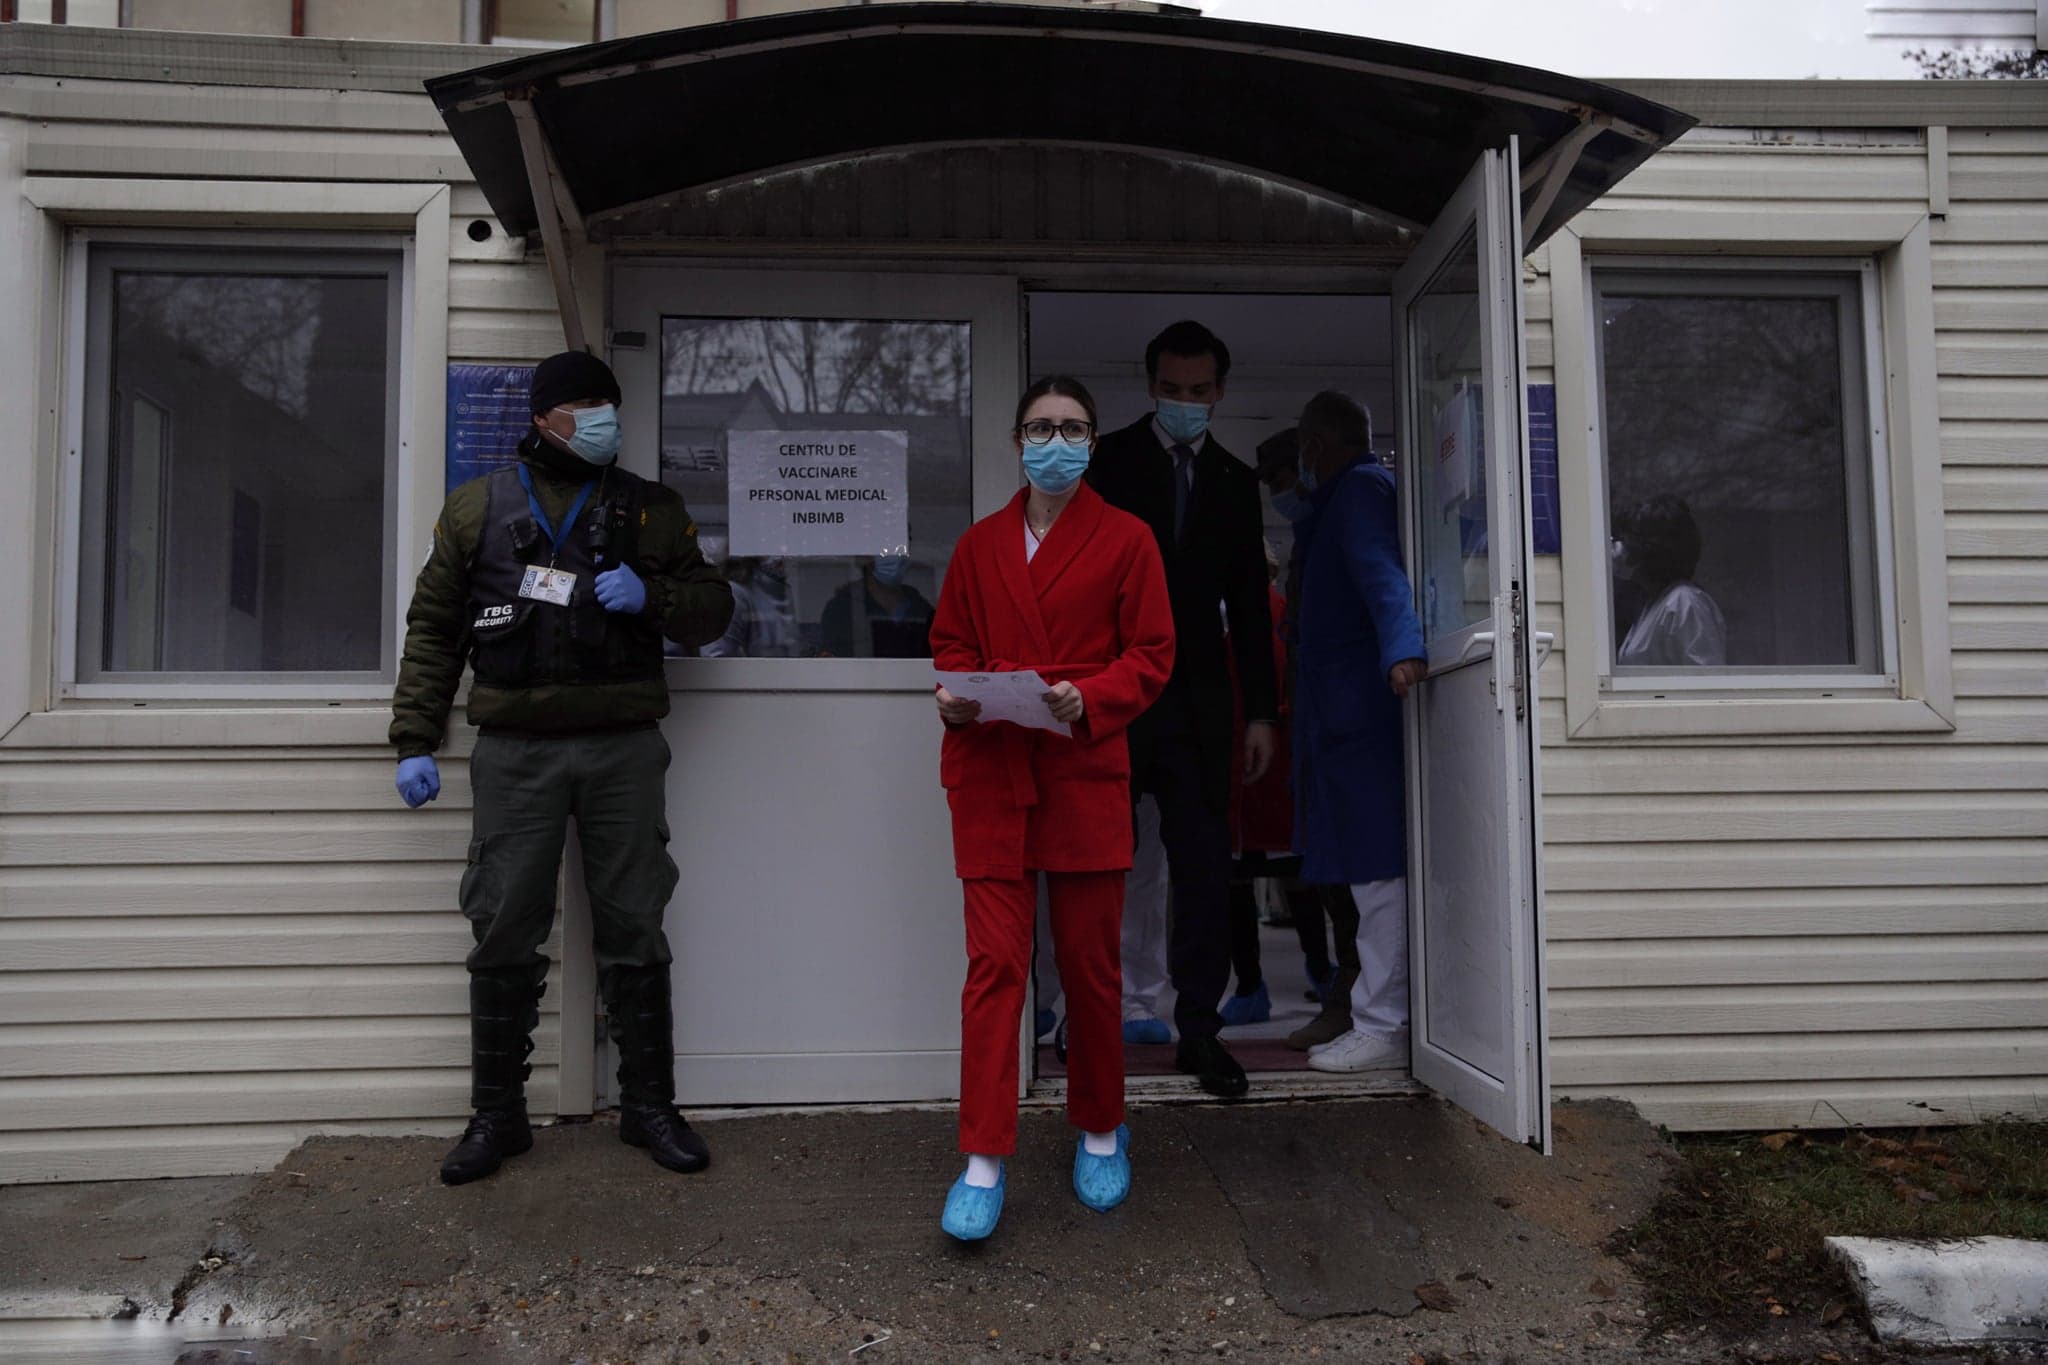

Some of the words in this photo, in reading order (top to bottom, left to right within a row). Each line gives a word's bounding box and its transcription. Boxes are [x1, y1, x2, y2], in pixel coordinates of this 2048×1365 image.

[779, 444, 834, 456] CENTRU
[839, 444, 856, 456] DE
[778, 467, 858, 479] VACCINARE
[749, 489, 821, 501] PERSONAL
[825, 489, 888, 501] MEDICAL
[792, 512, 845, 524] INBIMB
[474, 615, 513, 627] SECURITY
